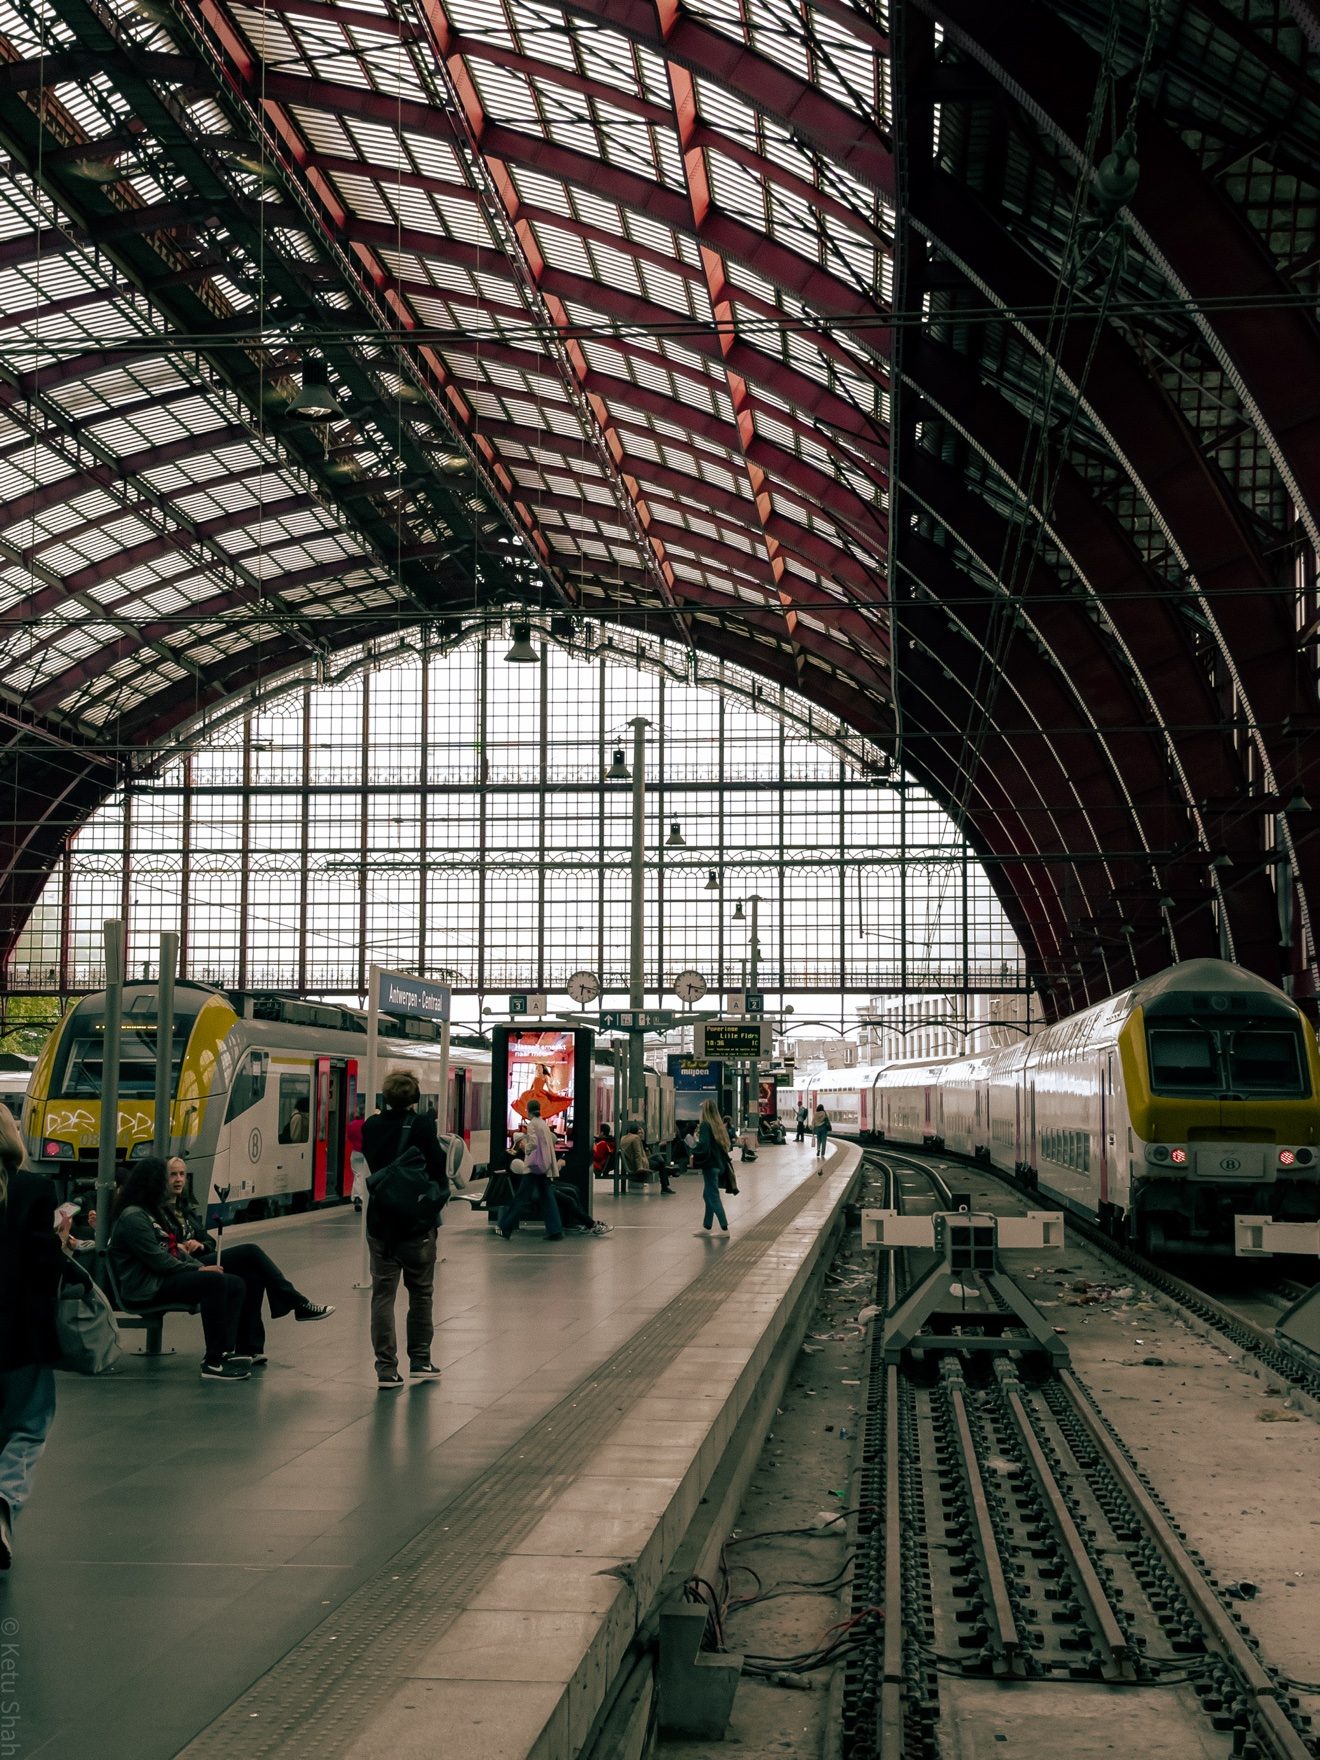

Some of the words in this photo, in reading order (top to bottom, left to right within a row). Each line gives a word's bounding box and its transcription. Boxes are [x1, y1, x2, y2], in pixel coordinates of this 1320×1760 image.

[389, 983, 418, 1011] Antwerpen
[422, 990, 443, 1011] Centraal
[751, 1001, 758, 1009] 2
[681, 1068, 709, 1077] miljoen
